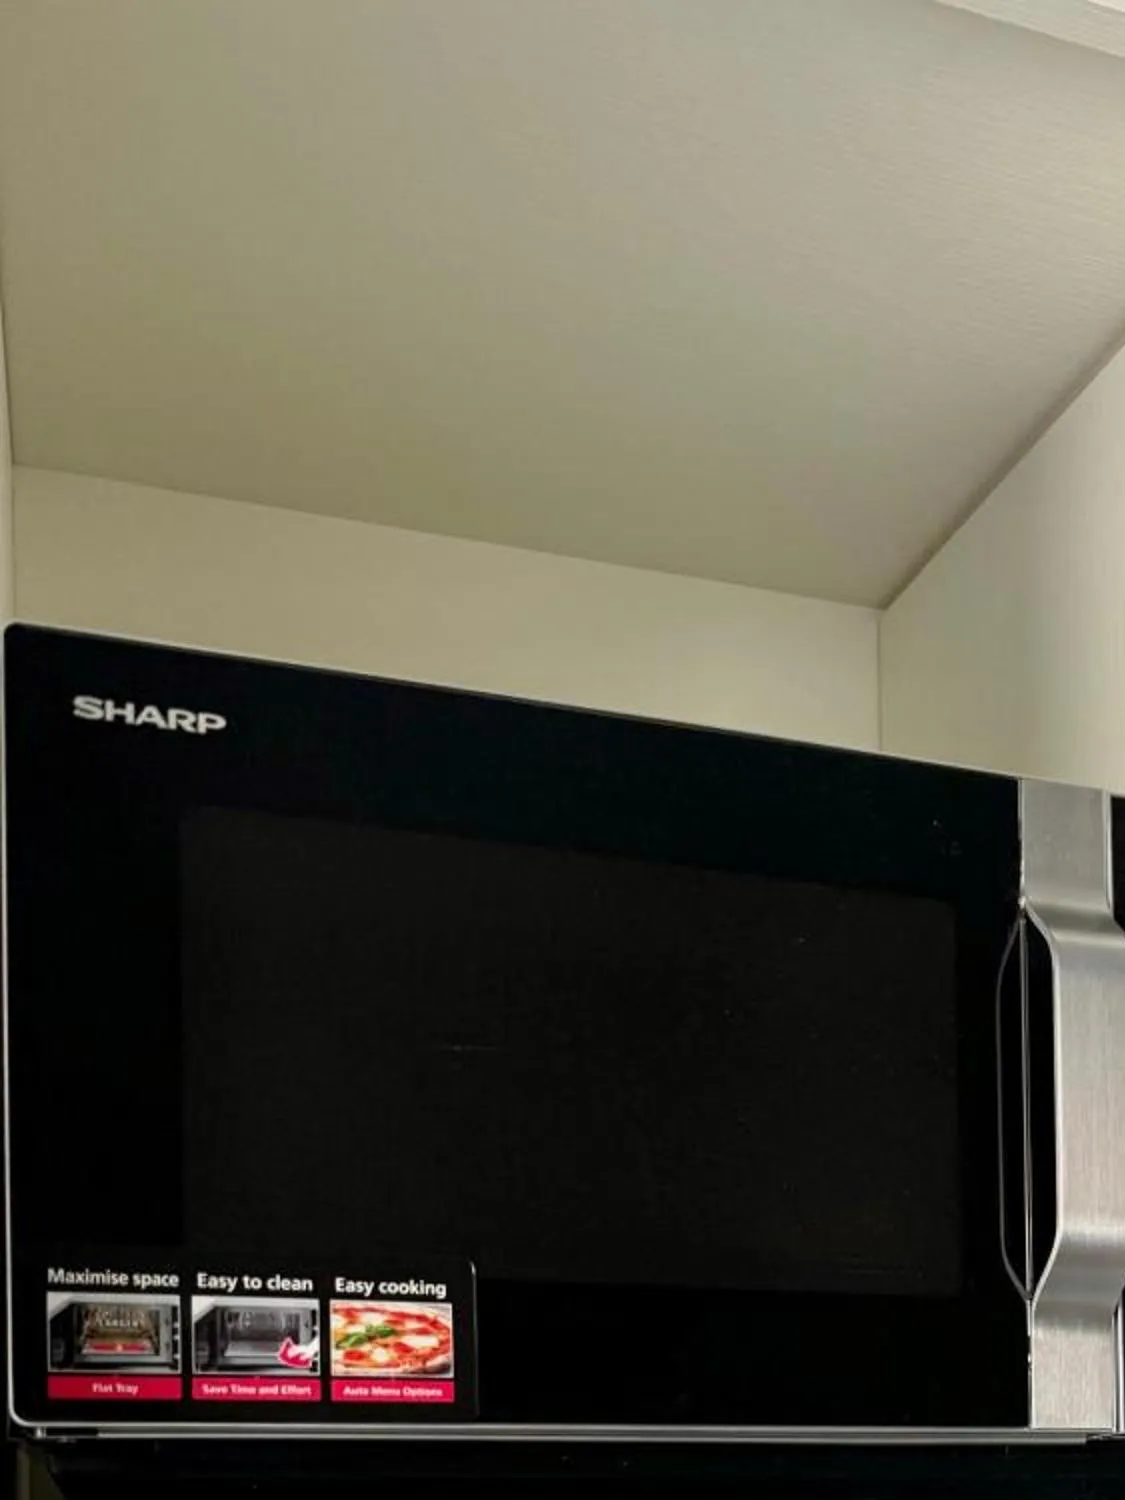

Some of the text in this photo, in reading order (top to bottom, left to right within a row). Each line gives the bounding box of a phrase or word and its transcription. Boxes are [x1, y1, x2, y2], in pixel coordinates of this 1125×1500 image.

[73, 695, 227, 735] SHARP
[47, 1267, 180, 1290] Maximise space
[197, 1271, 313, 1293] Easy to clean
[335, 1277, 447, 1300] Easy cooking
[92, 1382, 138, 1396] Flat Tray
[202, 1383, 228, 1395] Save
[230, 1383, 256, 1396] Time
